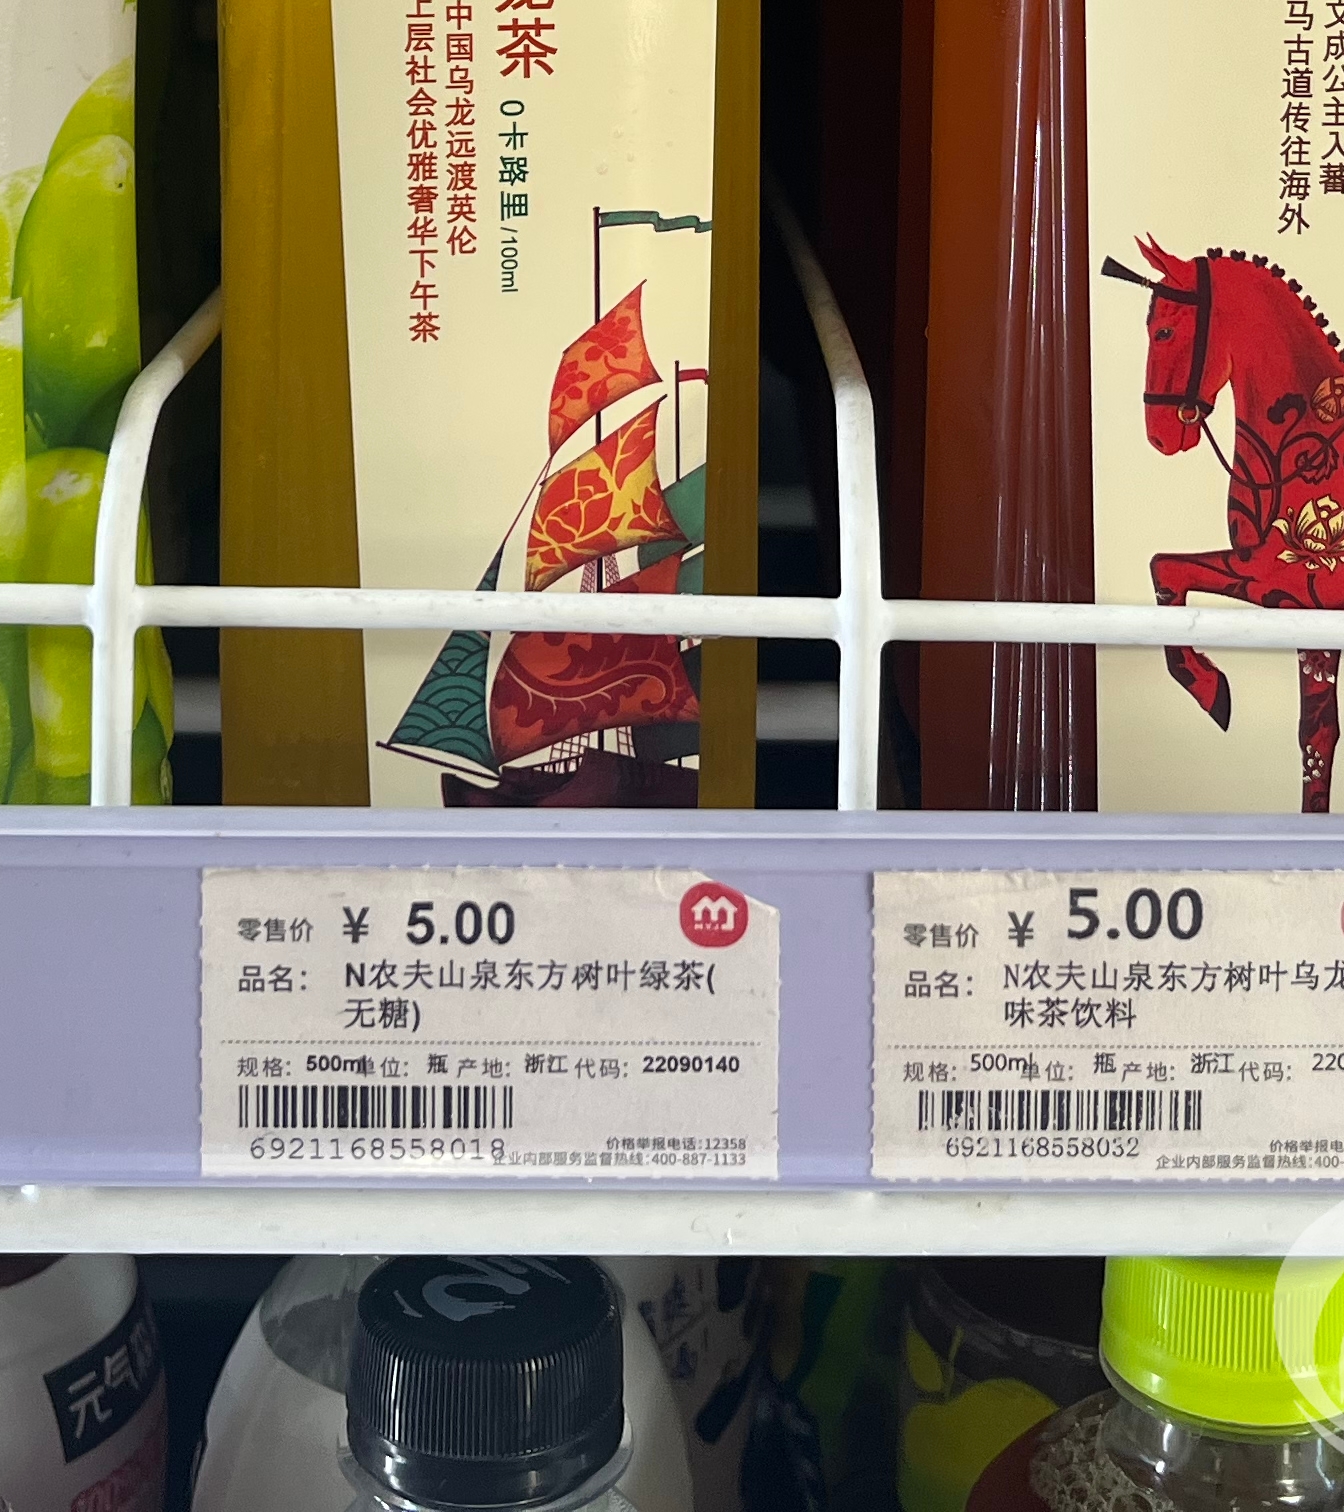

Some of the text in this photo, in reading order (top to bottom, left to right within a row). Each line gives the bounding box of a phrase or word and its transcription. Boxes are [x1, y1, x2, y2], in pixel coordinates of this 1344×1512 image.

[445, 0, 477, 256] 中国乌龙远渡英伦
[237, 918, 314, 942] 零售价
[405, 900, 516, 946] 5.00
[903, 923, 979, 949] 零售价
[1067, 887, 1204, 941] 5.00
[345, 960, 716, 993] N农夫山泉东方树叶绿茶(
[344, 998, 421, 1032] 无糖)
[1003, 996, 1137, 1028] 味茶饮料
[427, 1053, 740, 1075] 瓶 浙江 22090140
[1093, 1053, 1116, 1074] 瓶
[1191, 1053, 1234, 1074] 浙江
[250, 1137, 506, 1161] 6921168558018
[946, 1136, 1140, 1158] 6921168558032
